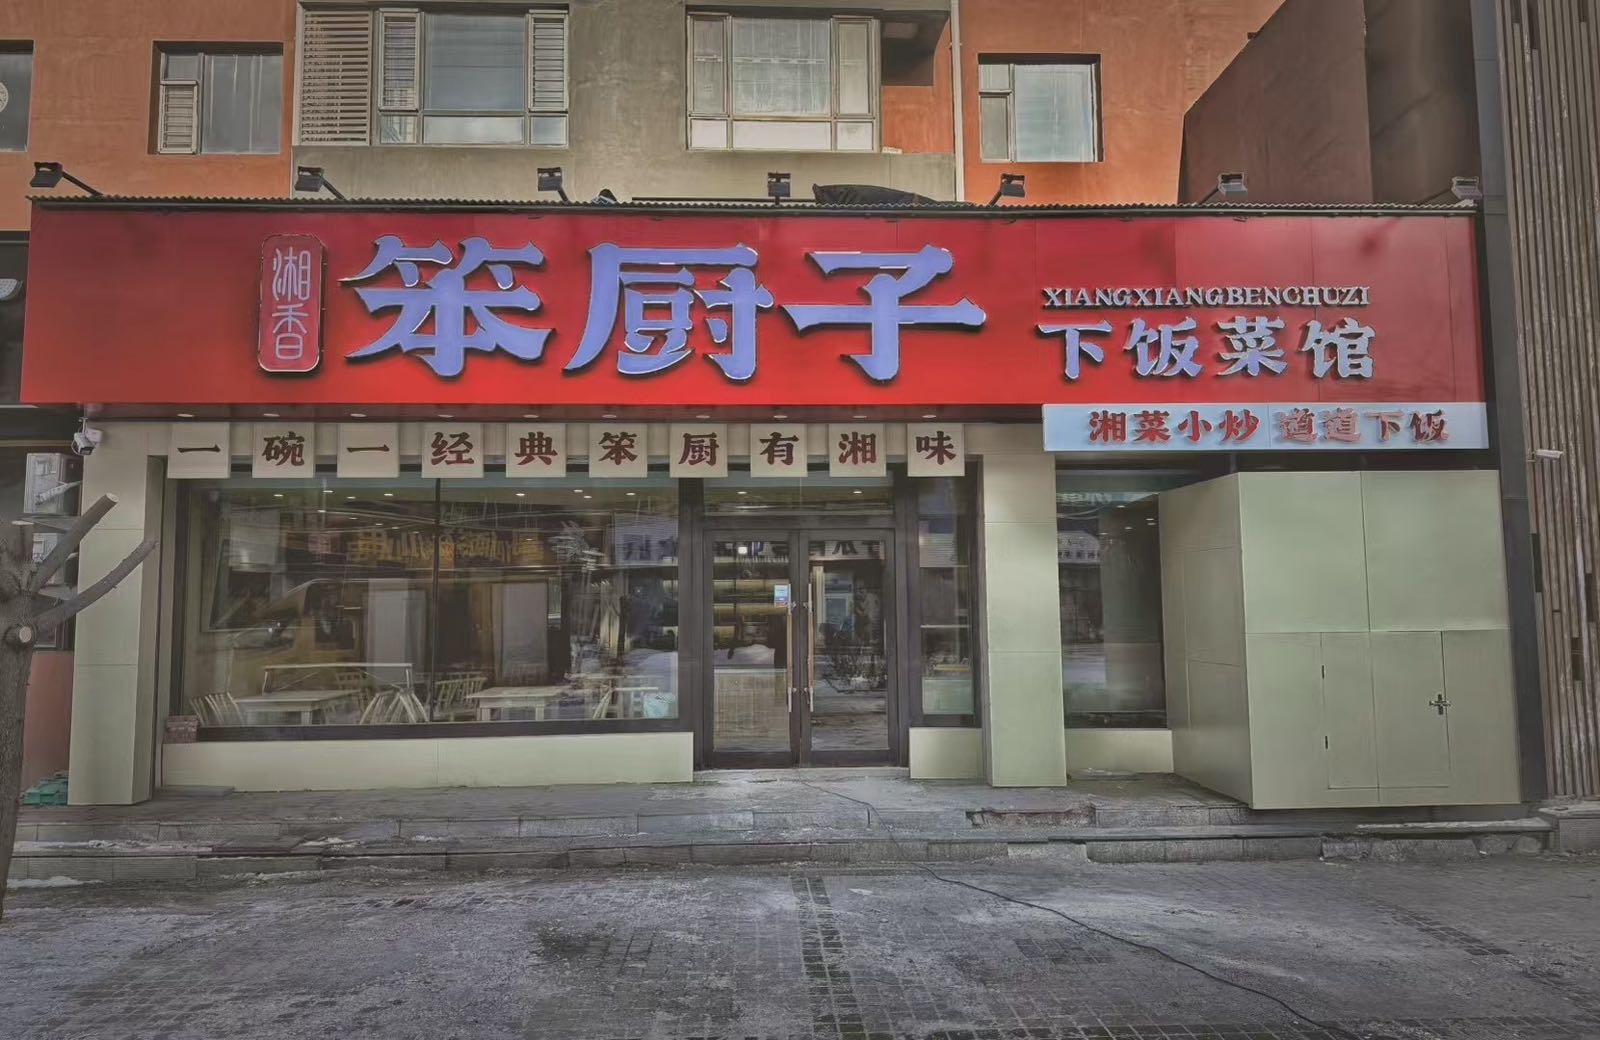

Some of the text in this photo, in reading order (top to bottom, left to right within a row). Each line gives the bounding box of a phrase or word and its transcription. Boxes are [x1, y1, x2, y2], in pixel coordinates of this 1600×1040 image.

[272, 247, 310, 360] 湘香
[338, 235, 987, 381] 笨厨子
[1043, 286, 1371, 306] XIANGXIANGBENCHUZI
[1037, 316, 1376, 380] 下饭菜馆
